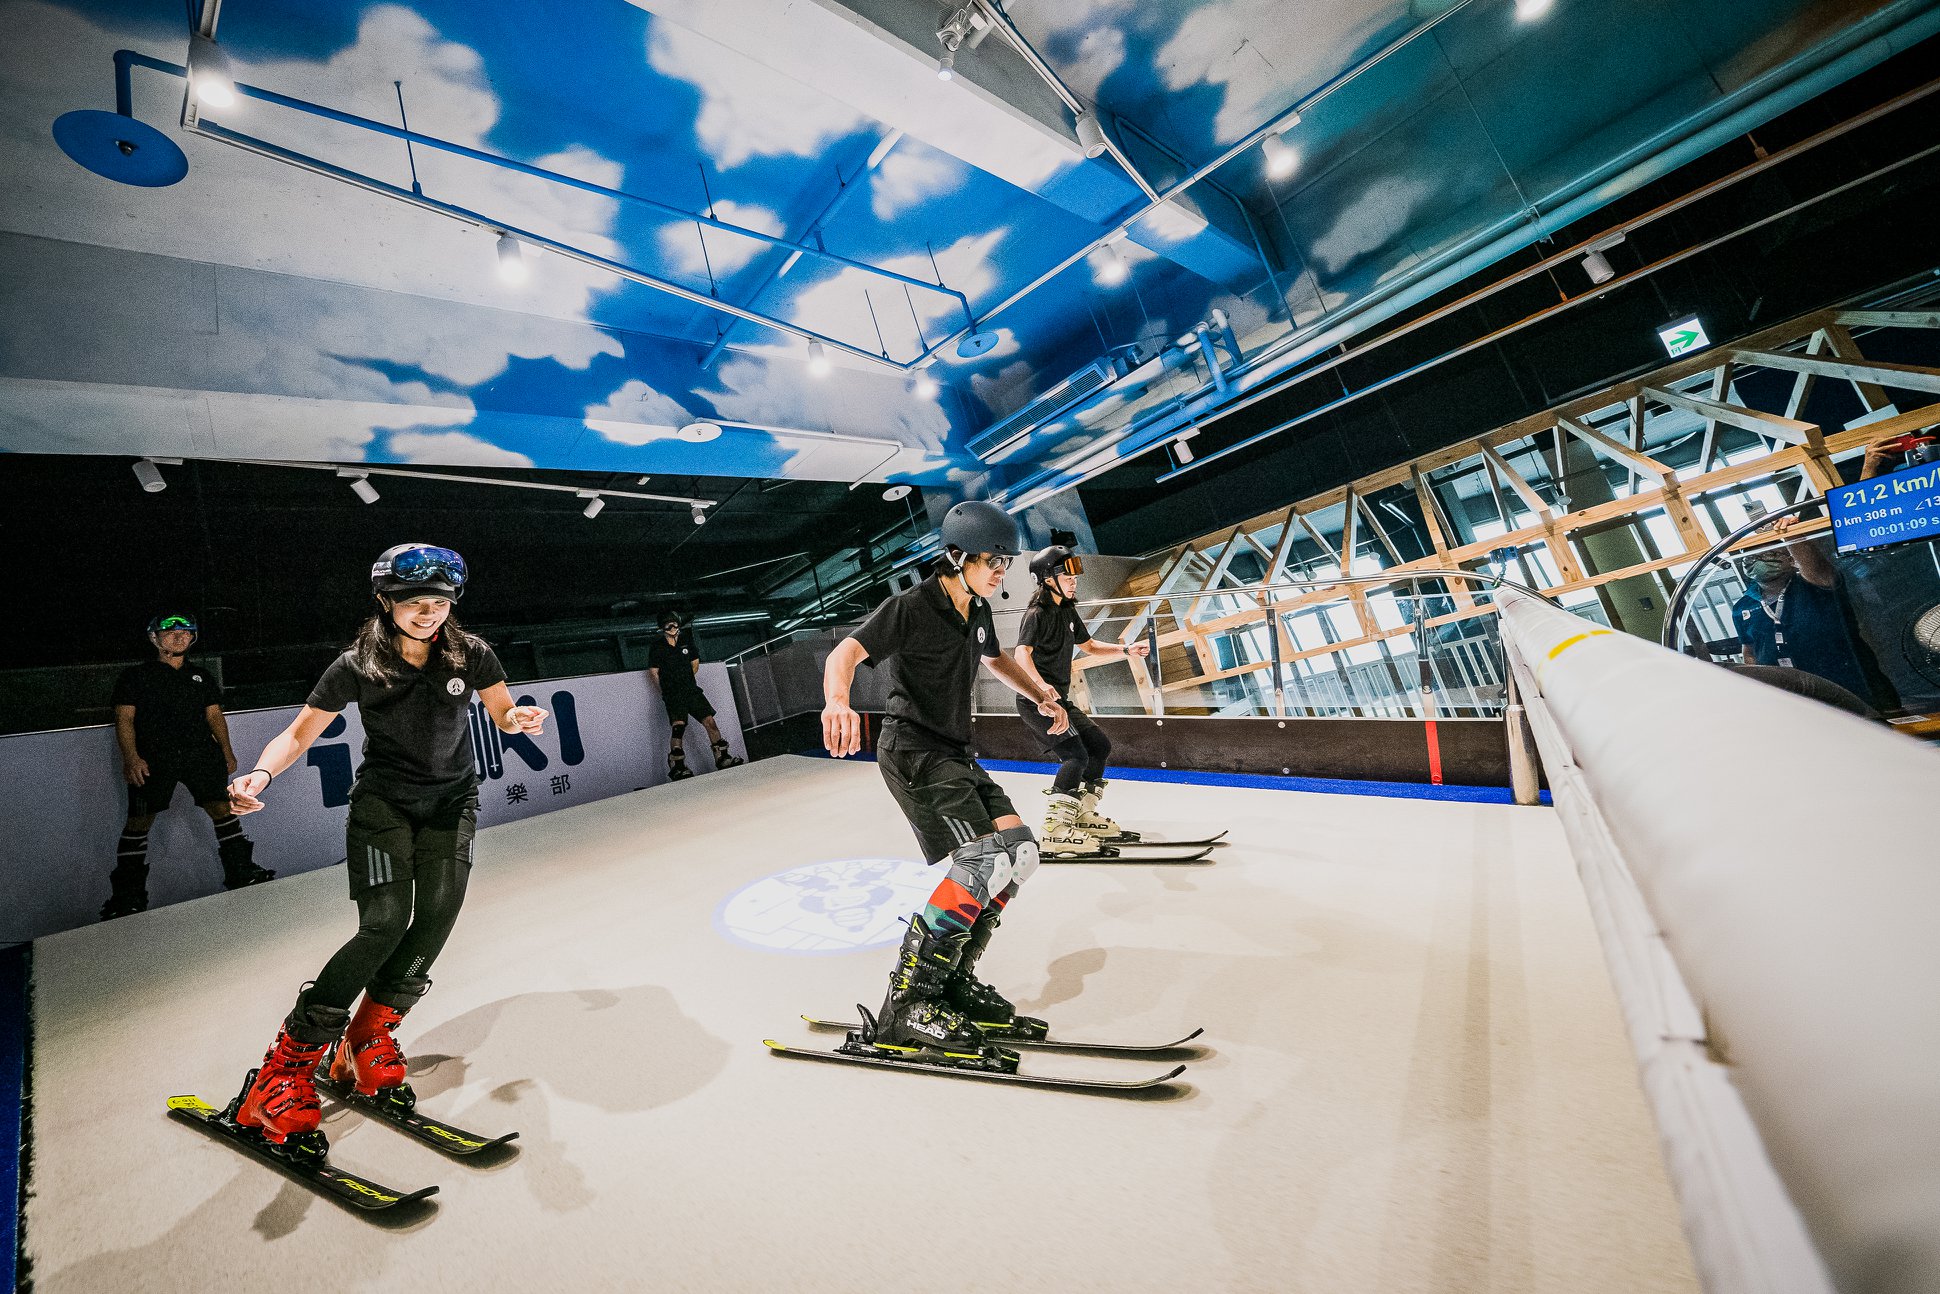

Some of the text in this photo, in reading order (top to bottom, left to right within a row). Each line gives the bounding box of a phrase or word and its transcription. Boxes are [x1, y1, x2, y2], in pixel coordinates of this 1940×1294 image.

[1843, 483, 1889, 508] 21,2
[1834, 518, 1842, 528] 0
[1844, 515, 1862, 527] km
[1864, 508, 1888, 521] 308
[1890, 506, 1903, 516] m
[1869, 517, 1928, 538] 00:01:09
[1042, 836, 1084, 845] HEAD
[906, 1018, 946, 1040] HEAD
